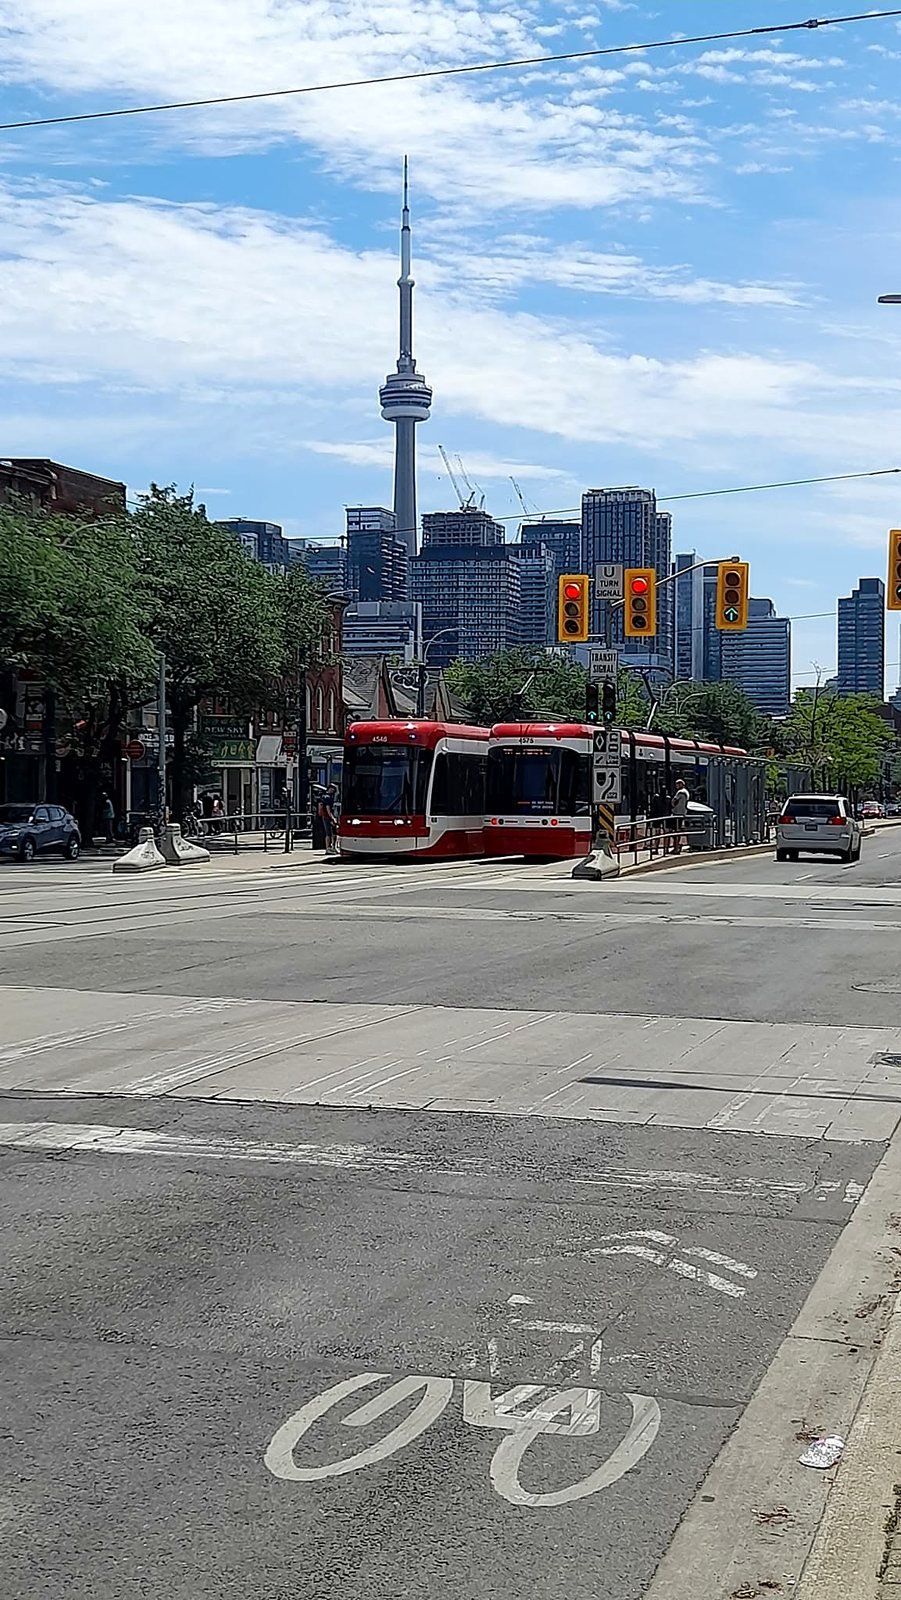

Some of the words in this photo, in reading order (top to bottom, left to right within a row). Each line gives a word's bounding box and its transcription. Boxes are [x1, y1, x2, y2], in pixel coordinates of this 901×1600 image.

[603, 566, 615, 578] U
[596, 589, 622, 598] SIGNAL
[592, 653, 616, 662] TRANSIT
[592, 664, 614, 673] SIGNAL
[226, 726, 245, 734] SKY
